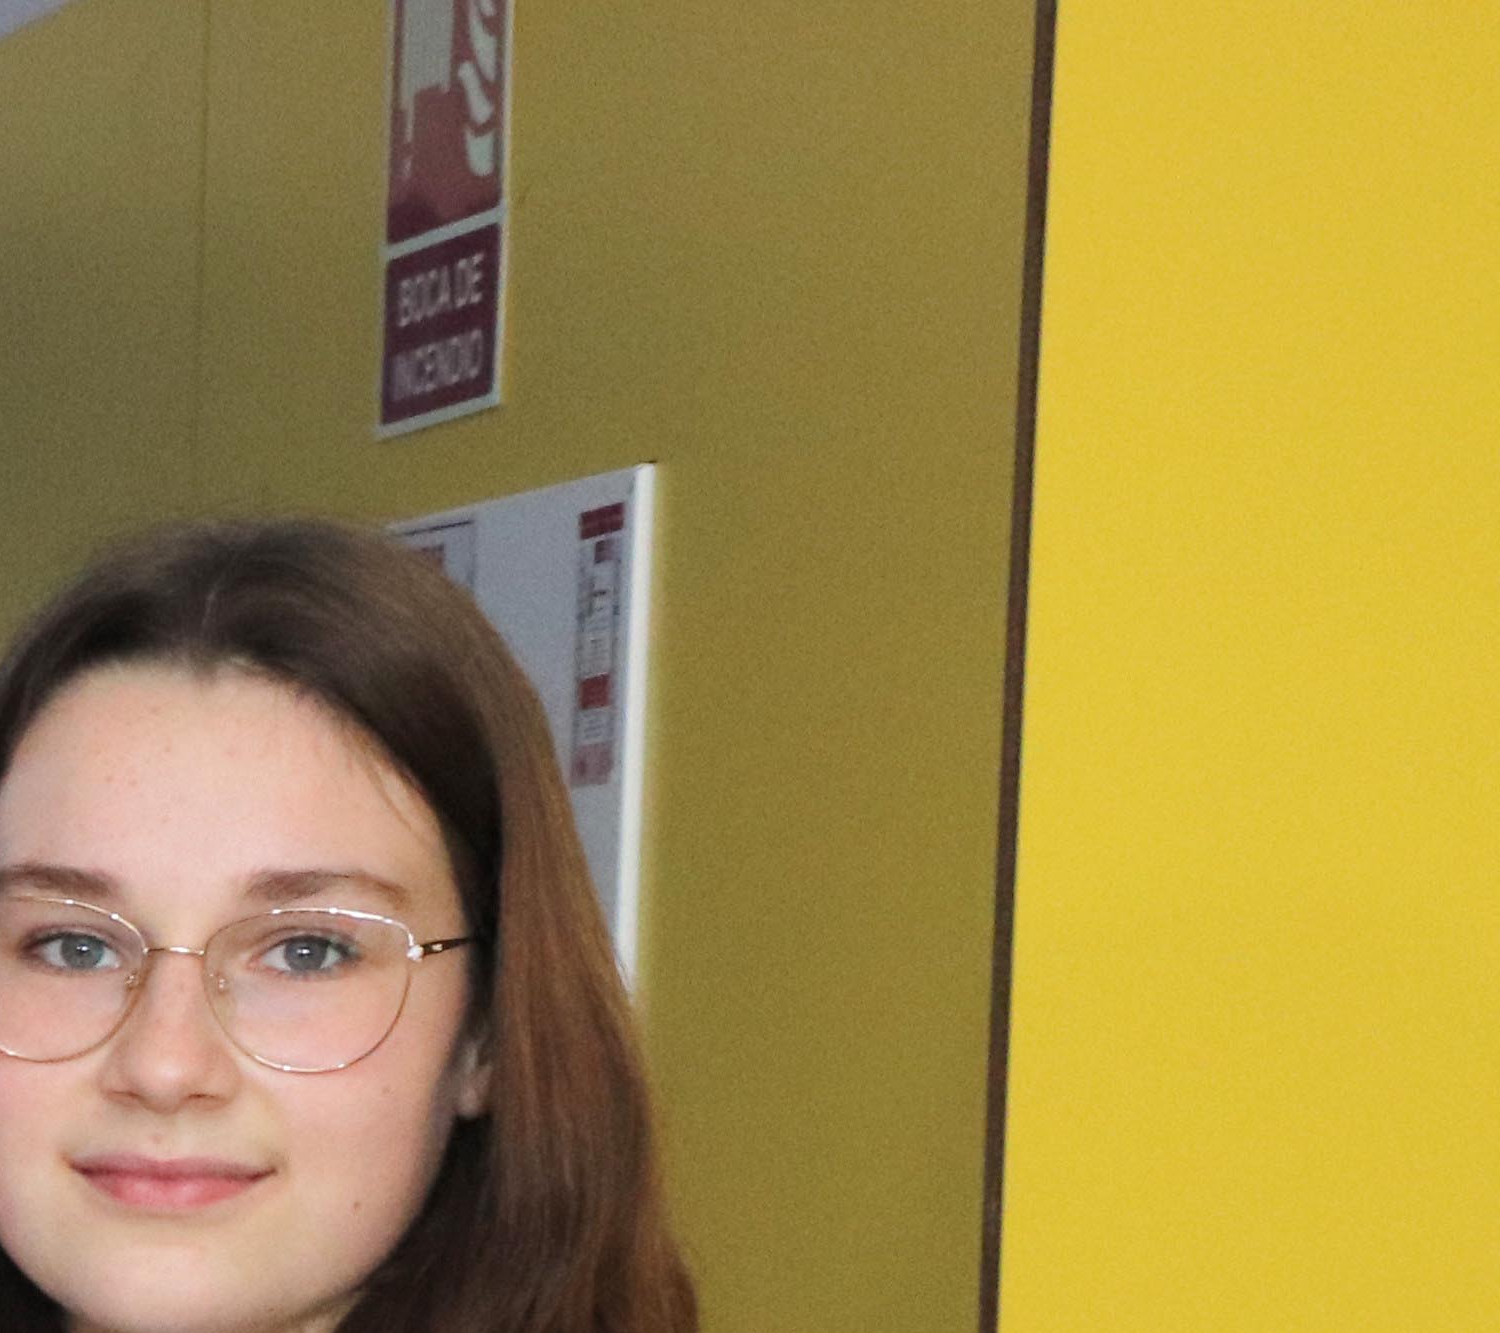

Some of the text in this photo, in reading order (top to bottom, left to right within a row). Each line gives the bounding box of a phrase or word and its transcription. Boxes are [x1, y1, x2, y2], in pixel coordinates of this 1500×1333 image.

[398, 252, 486, 329] BOCA DE
[391, 328, 484, 402] INCENDIO
